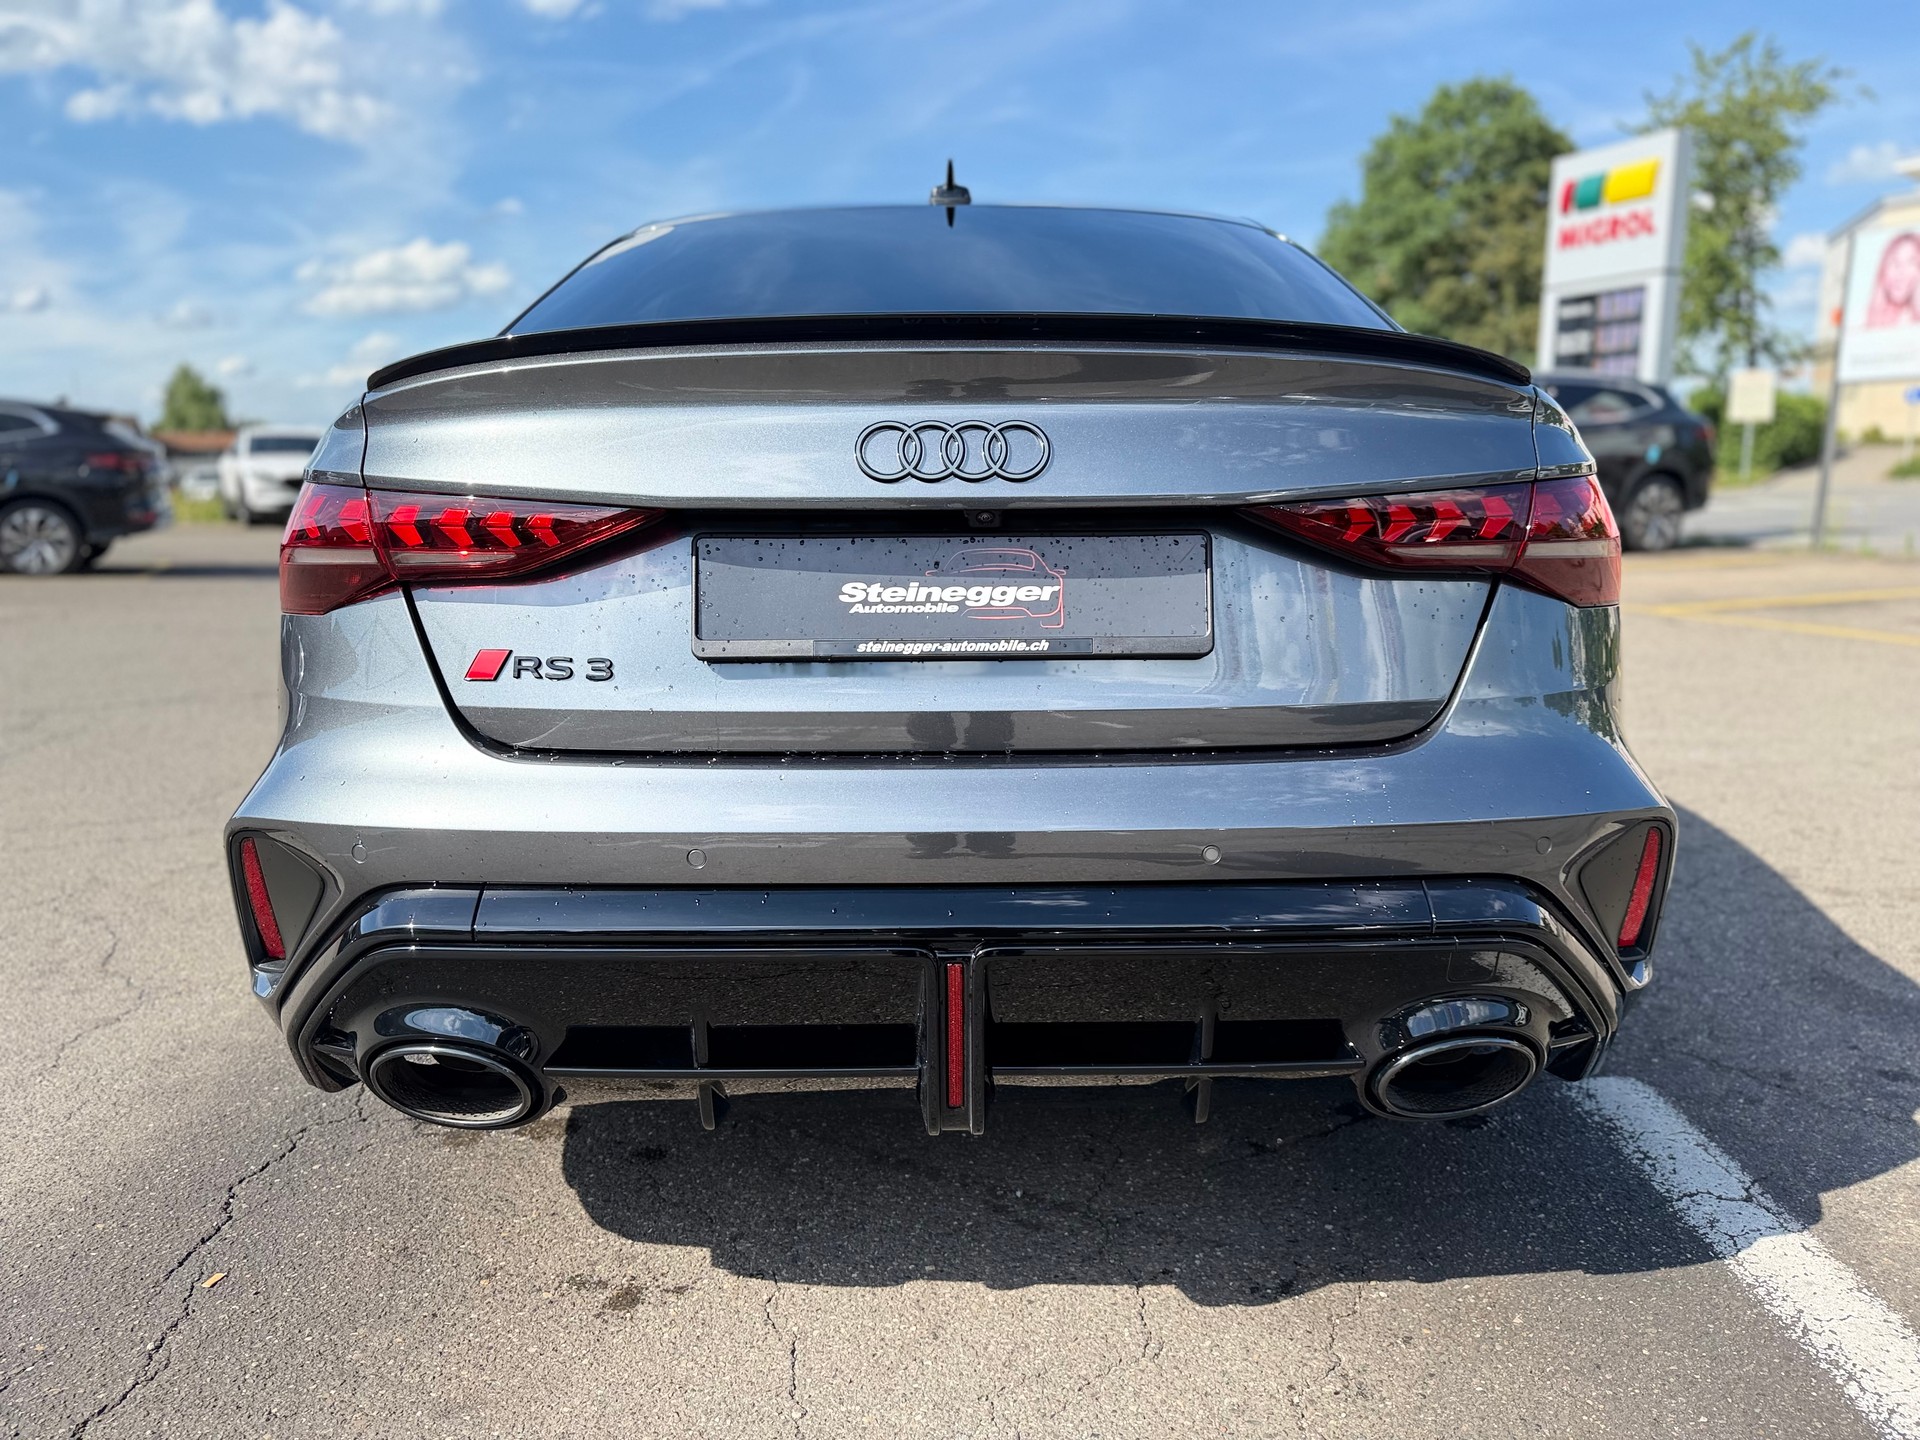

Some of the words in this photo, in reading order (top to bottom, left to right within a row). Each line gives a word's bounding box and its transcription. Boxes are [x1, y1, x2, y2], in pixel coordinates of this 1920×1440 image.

[838, 582, 1061, 606] Steinegger
[849, 602, 959, 614] Automobile
[857, 640, 1049, 655] steinegger-automobile.ch
[513, 656, 574, 681] RS
[585, 657, 614, 682] 3
